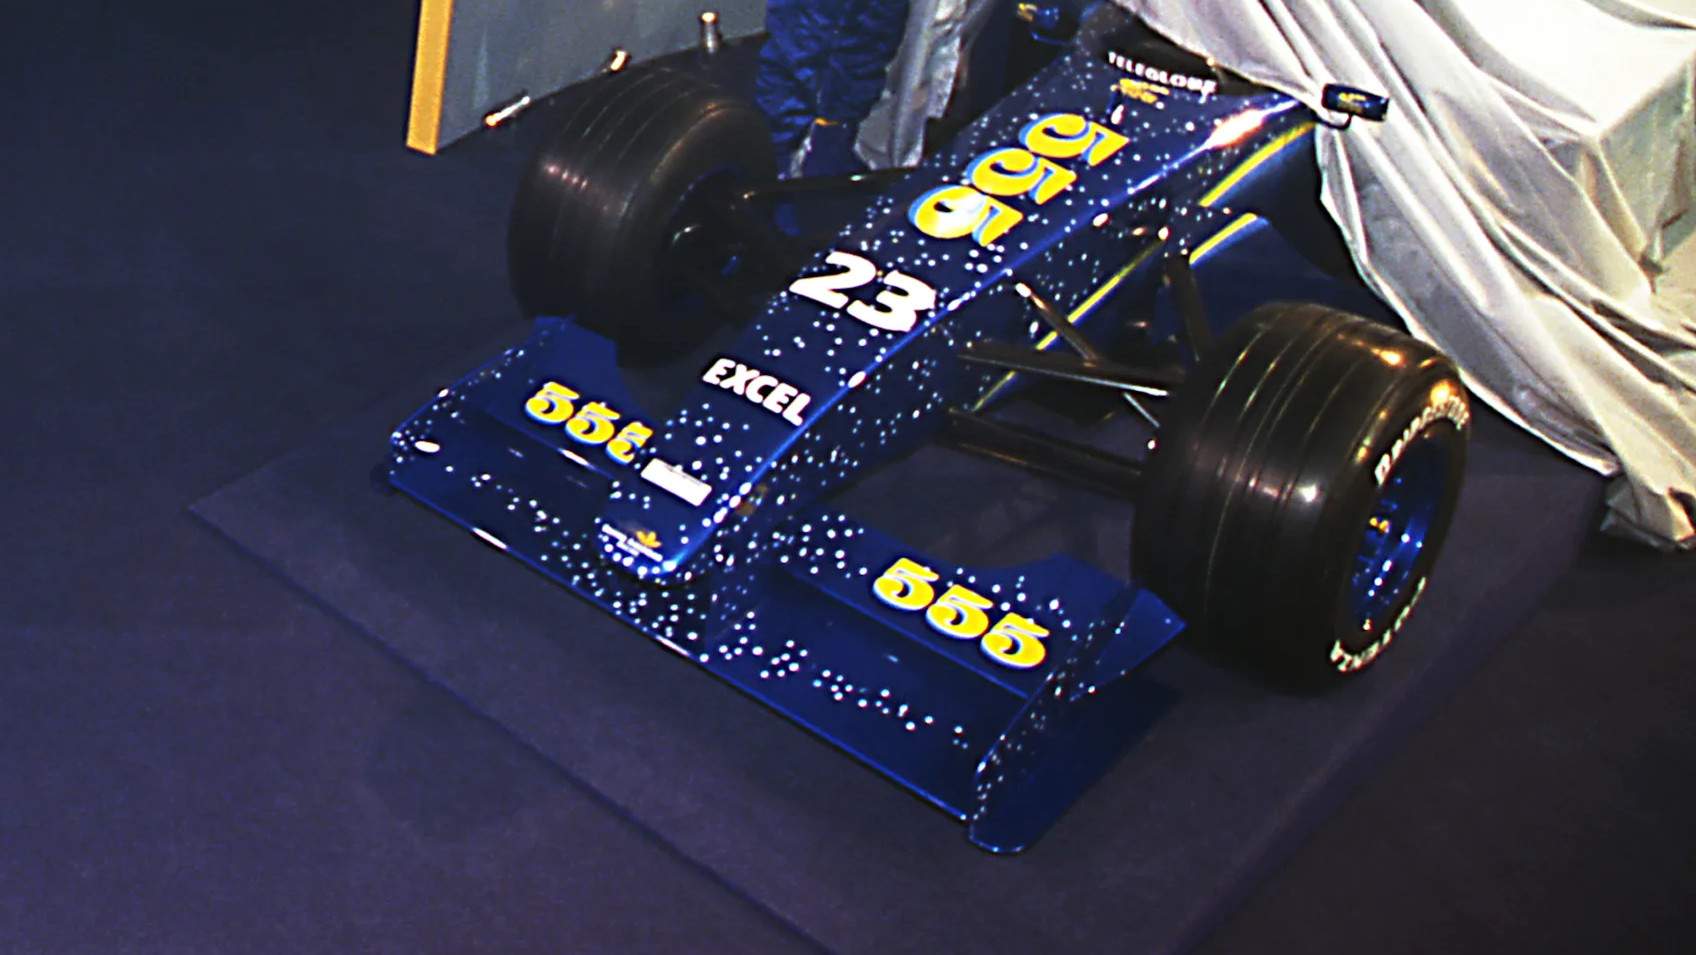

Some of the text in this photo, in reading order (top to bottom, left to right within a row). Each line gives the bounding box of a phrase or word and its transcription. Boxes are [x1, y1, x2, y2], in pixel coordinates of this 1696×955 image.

[908, 112, 1131, 247] 555
[788, 250, 936, 333] 23
[702, 357, 812, 427] EXCEL
[871, 556, 1051, 671] 555
